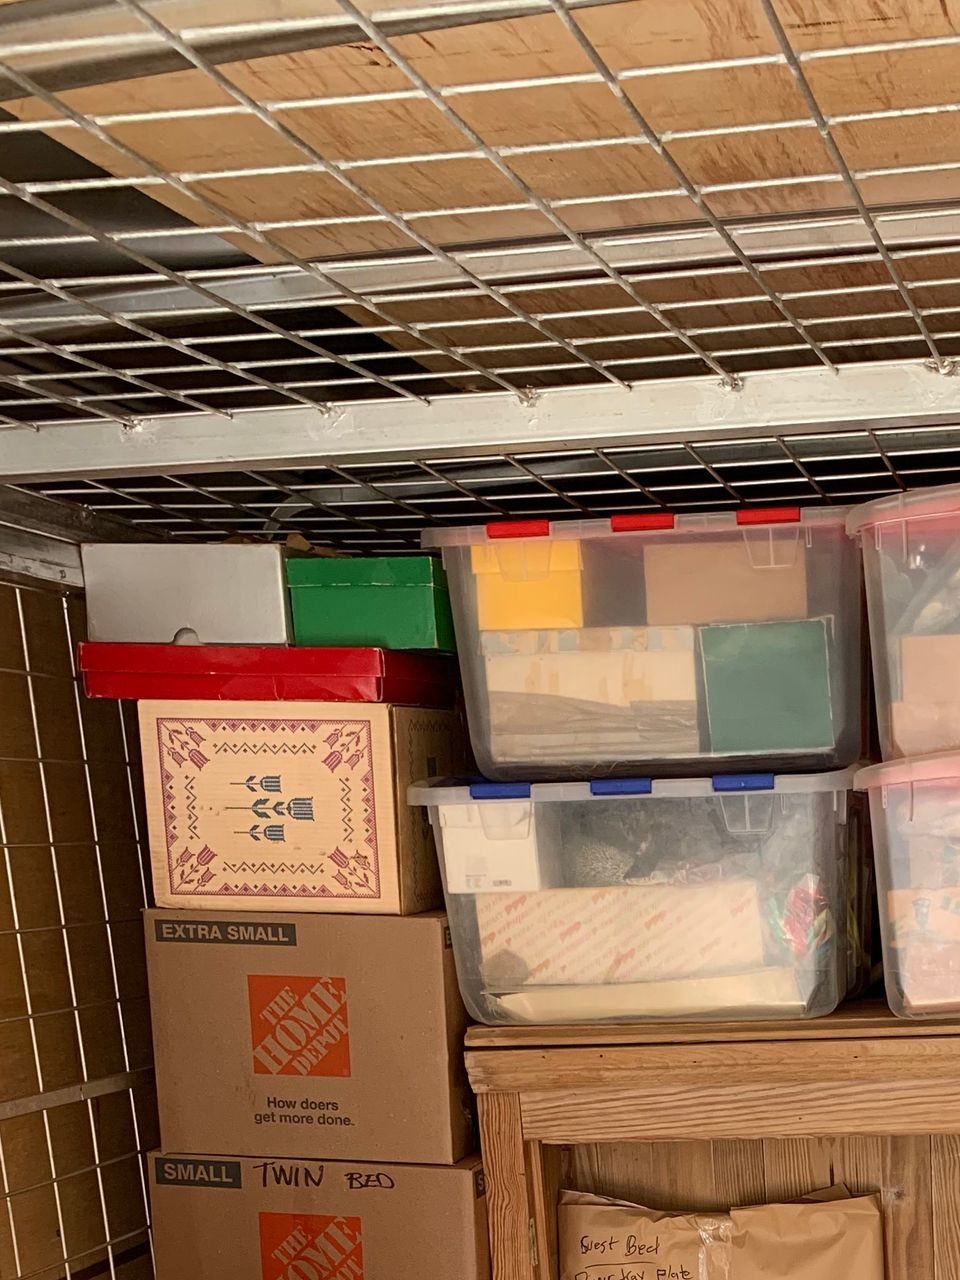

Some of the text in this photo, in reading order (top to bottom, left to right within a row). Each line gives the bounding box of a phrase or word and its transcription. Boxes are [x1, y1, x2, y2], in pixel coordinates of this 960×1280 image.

[162, 923, 289, 942] EXTRA SMALL
[259, 986, 299, 1026] THE
[253, 976, 347, 1076] HOME
[292, 1014, 349, 1077] DEPOT
[267, 1096, 339, 1112] How doers
[254, 1110, 277, 1125] get
[280, 1112, 313, 1125] more
[163, 1163, 233, 1184] SMALL
[253, 1161, 325, 1188] TWIN
[271, 1226, 313, 1267] THE
[625, 1234, 660, 1256] Bed
